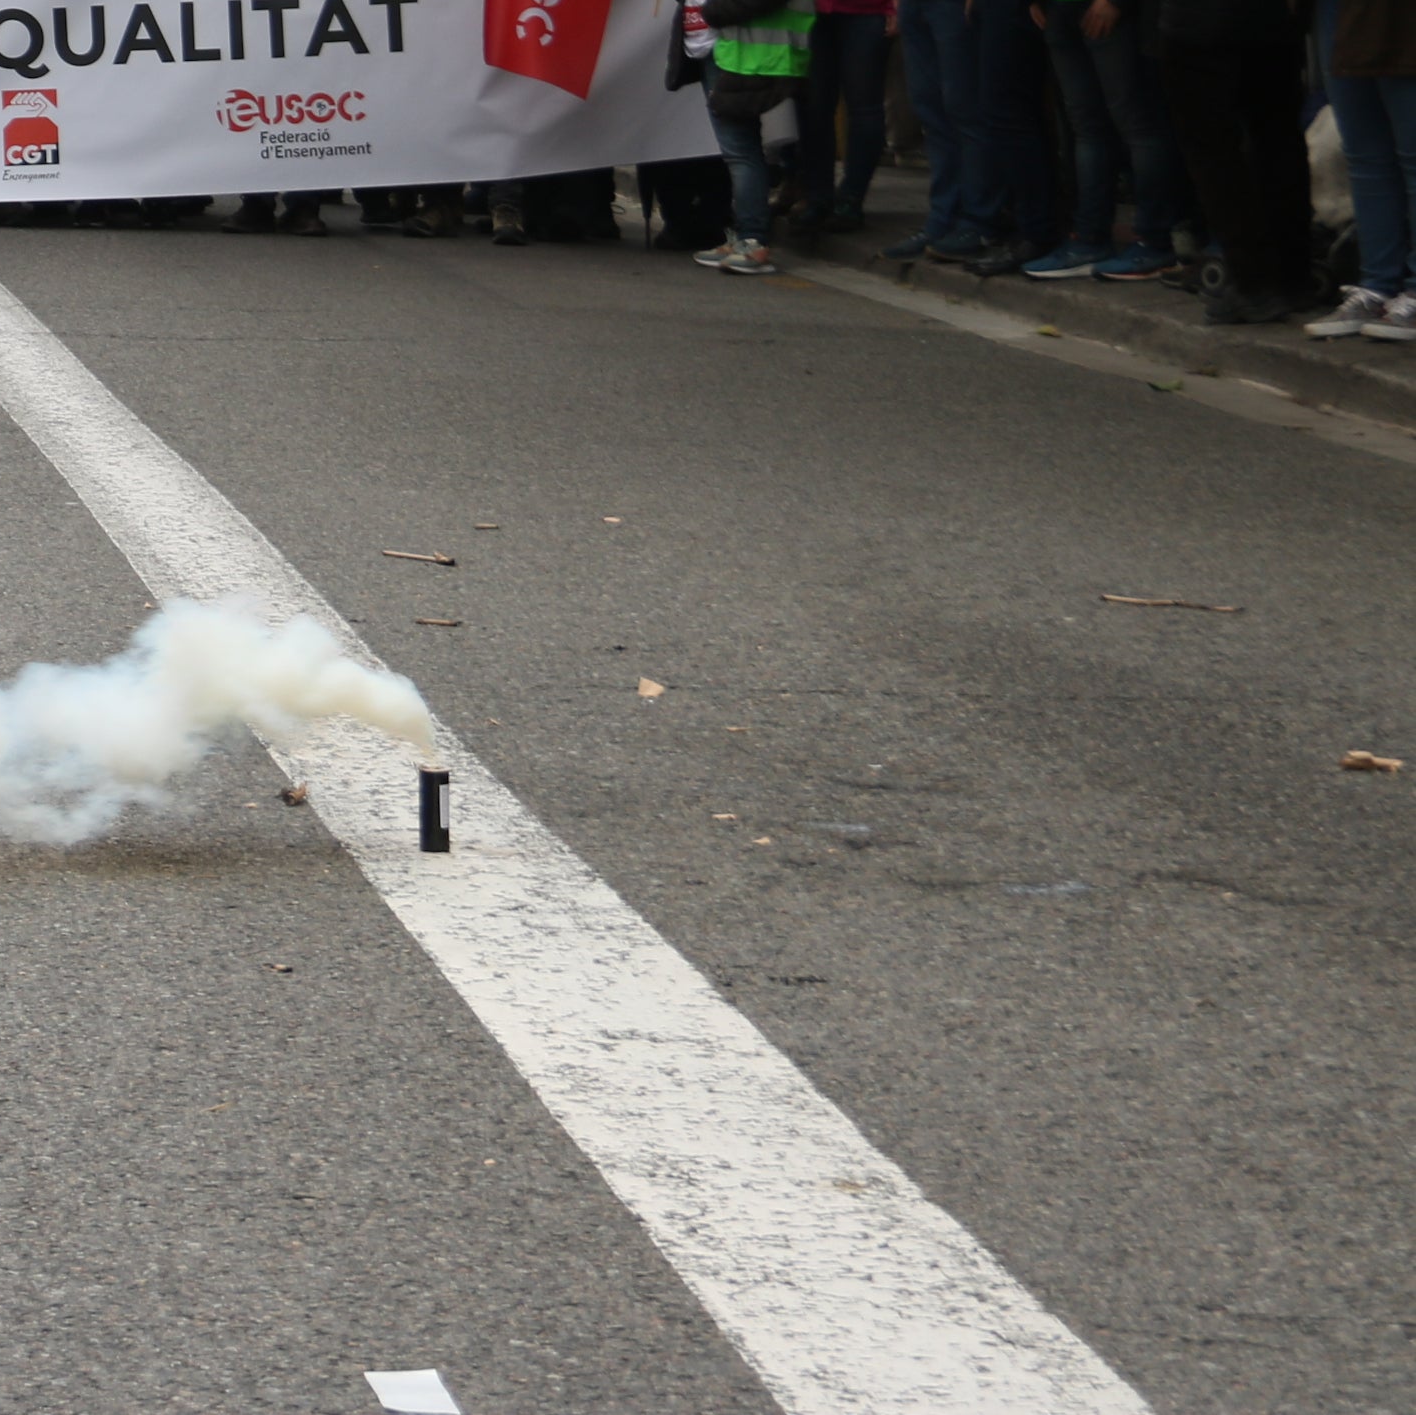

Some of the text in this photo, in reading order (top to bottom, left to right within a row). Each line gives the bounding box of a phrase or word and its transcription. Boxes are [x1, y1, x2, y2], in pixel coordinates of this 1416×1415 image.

[260, 128, 331, 144] Federació
[6, 144, 58, 165] CGT
[261, 142, 373, 160] d'Ensenyament
[2, 169, 61, 183] Ensenyament
